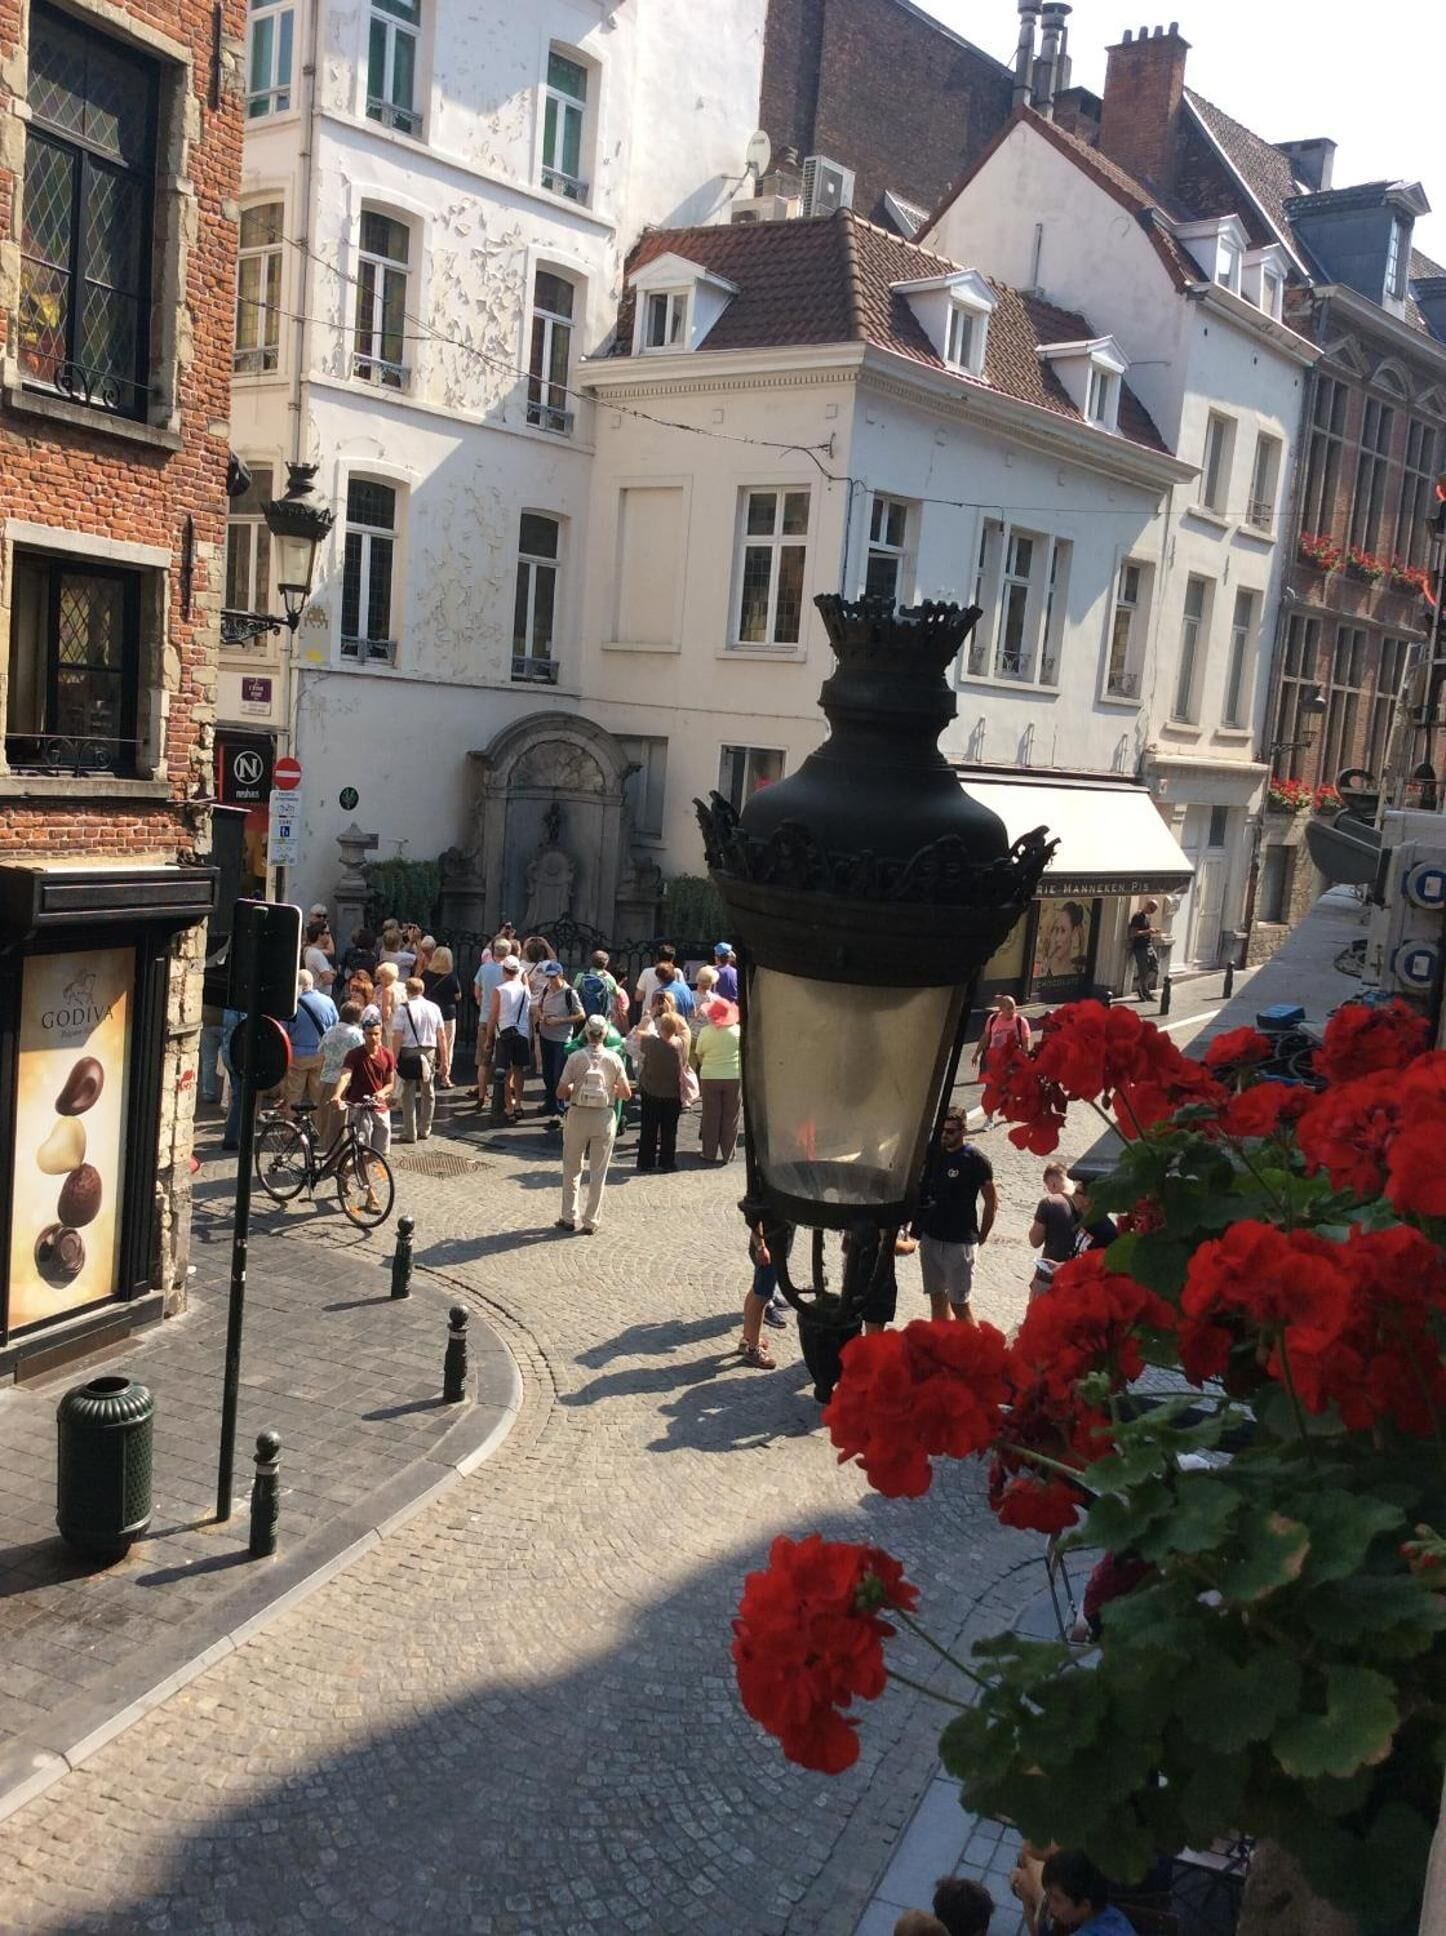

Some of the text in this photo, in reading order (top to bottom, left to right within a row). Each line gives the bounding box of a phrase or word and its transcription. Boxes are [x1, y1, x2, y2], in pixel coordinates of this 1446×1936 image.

[239, 758, 258, 778] N
[1063, 882, 1125, 895] MANNEKEN
[41, 1005, 114, 1030] GODIVA
